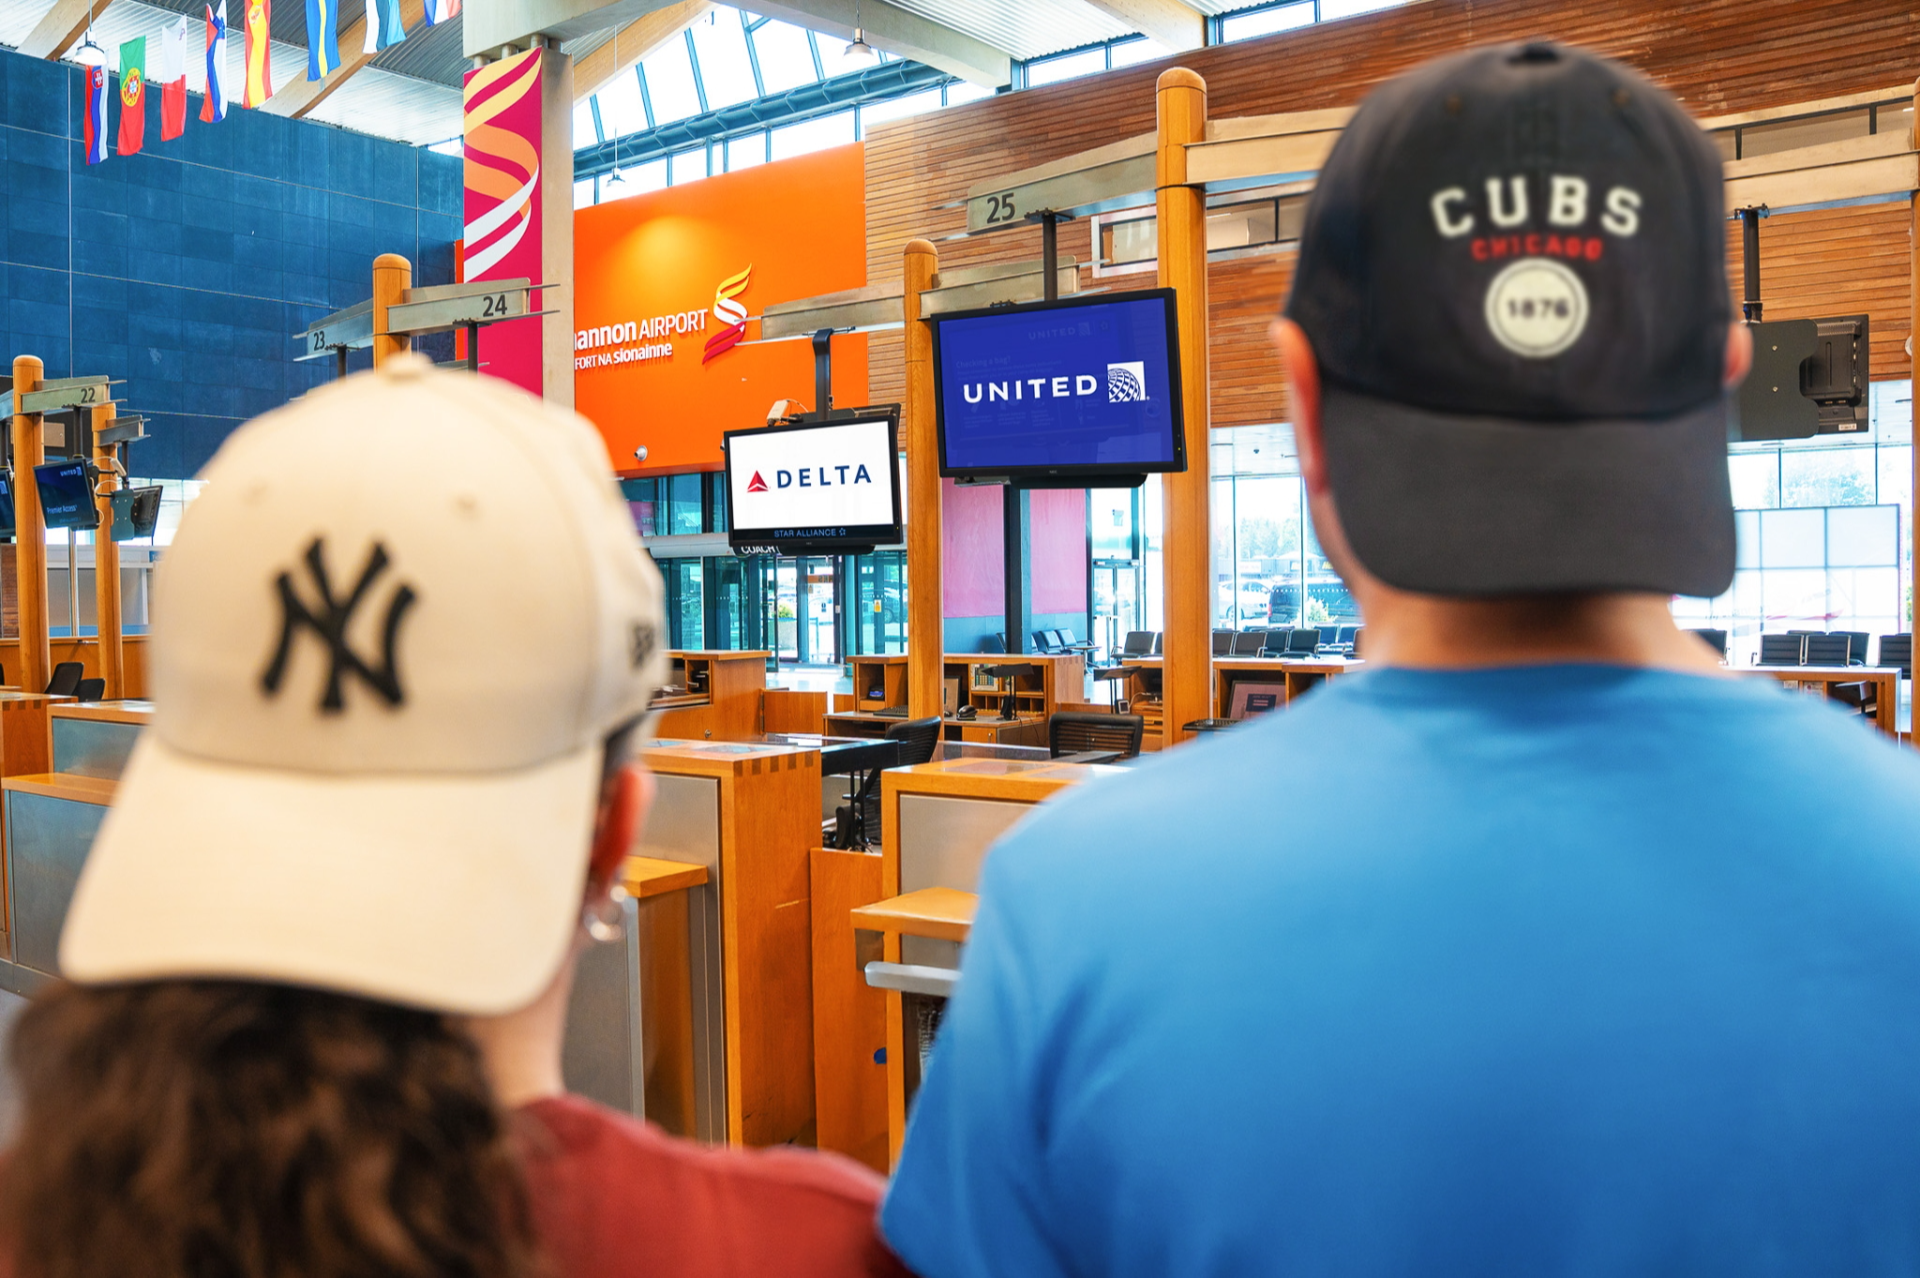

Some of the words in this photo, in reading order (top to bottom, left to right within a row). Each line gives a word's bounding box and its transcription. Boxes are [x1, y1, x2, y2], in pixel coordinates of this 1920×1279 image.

[986, 192, 1016, 224] 25
[1431, 175, 1642, 238] CUBS
[1471, 235, 1602, 260] CHICAGO
[482, 294, 508, 317] 24
[639, 308, 708, 339] AIRPORT
[313, 330, 326, 351] 23
[598, 351, 612, 366] NA
[613, 343, 672, 363] sionainne
[80, 387, 96, 404] 22
[962, 374, 1098, 404] UNITED
[776, 464, 872, 489] DELTA
[774, 529, 795, 538] STAR
[796, 528, 837, 537] ALLIANCE
